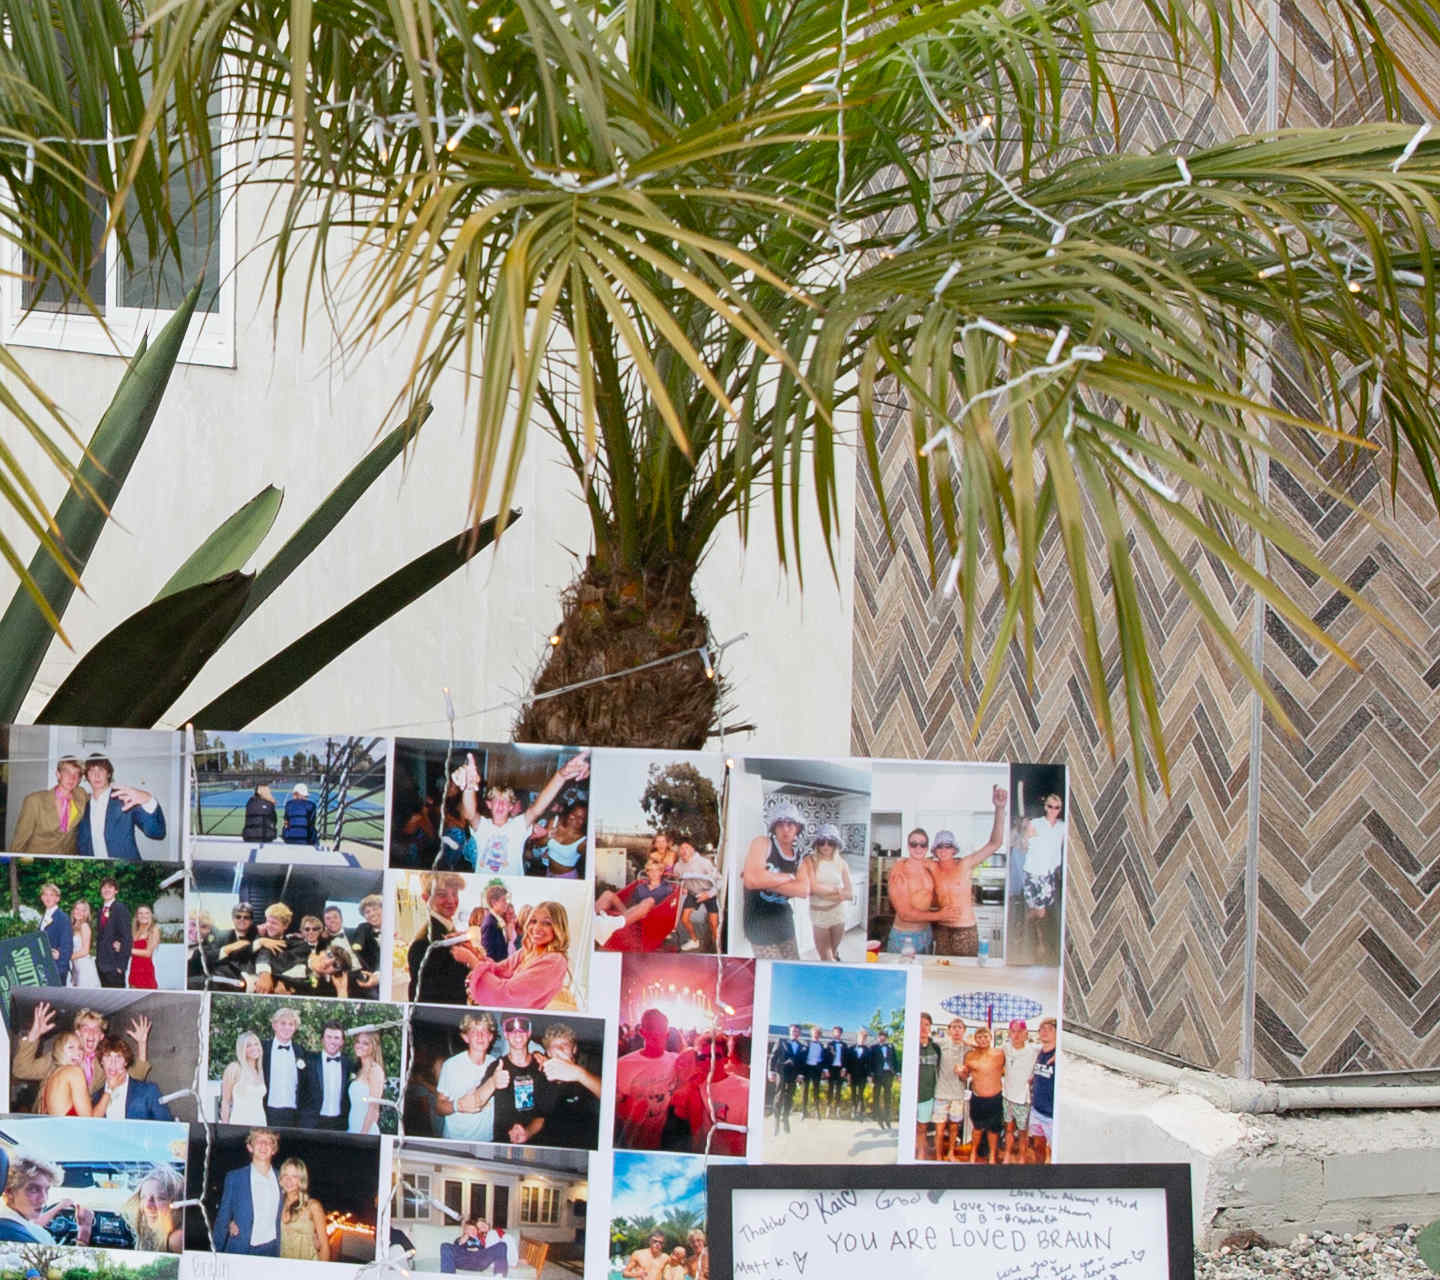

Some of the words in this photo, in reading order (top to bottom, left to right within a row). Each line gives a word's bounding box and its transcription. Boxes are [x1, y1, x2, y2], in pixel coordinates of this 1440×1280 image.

[952, 1199, 984, 1213] Love
[986, 1201, 1011, 1214] You
[826, 1228, 880, 1254] YOU
[1035, 1225, 1113, 1251] BRAUN
